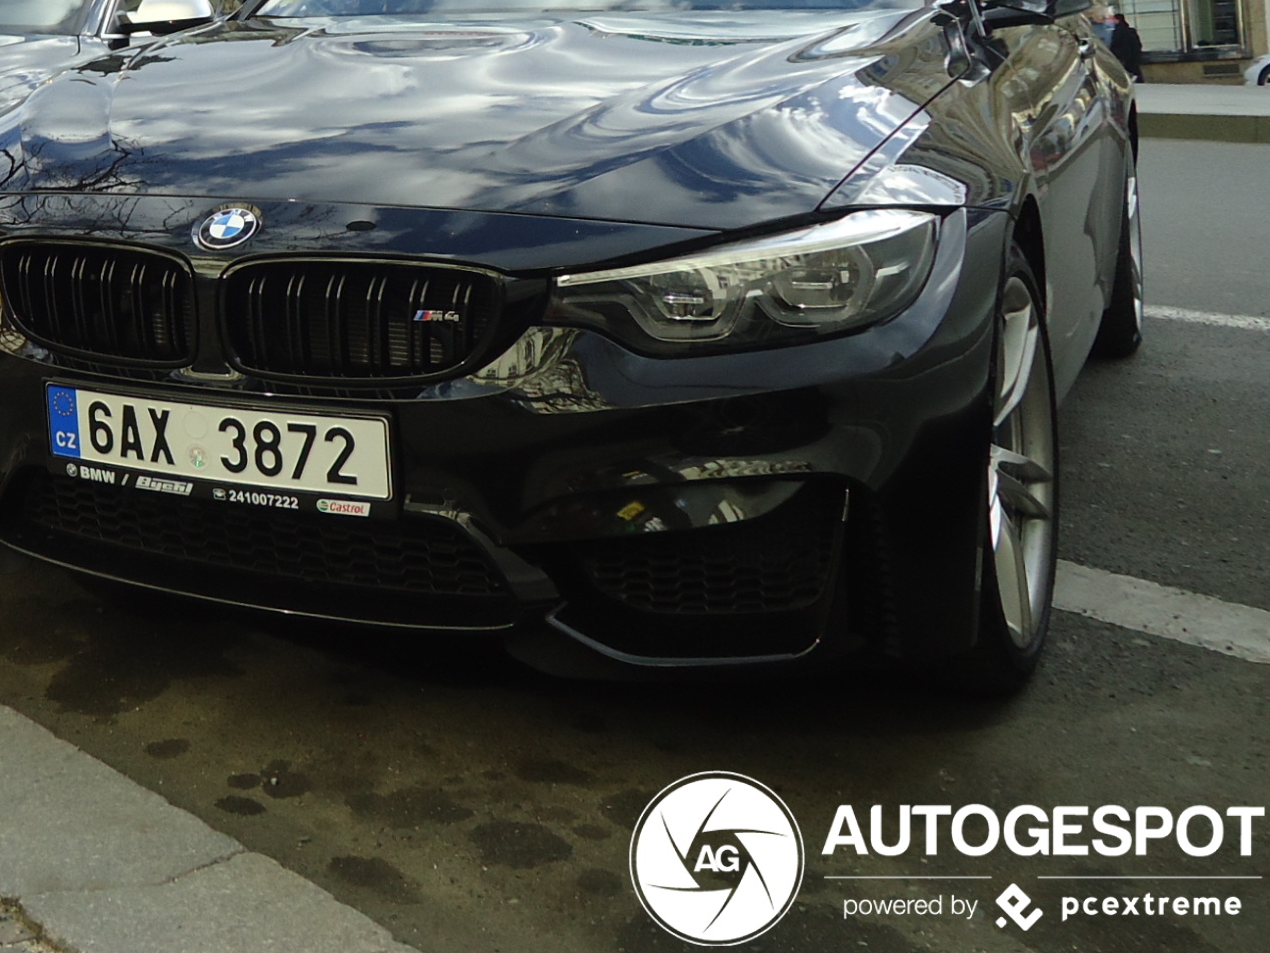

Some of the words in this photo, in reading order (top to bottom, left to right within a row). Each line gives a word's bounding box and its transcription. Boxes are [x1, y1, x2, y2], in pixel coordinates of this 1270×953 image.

[56, 431, 77, 448] CZ
[88, 400, 175, 465] 6AX
[218, 417, 357, 485] 3872
[80, 466, 115, 484] BMW
[229, 490, 299, 509] 241007222
[330, 501, 365, 515] Castrol
